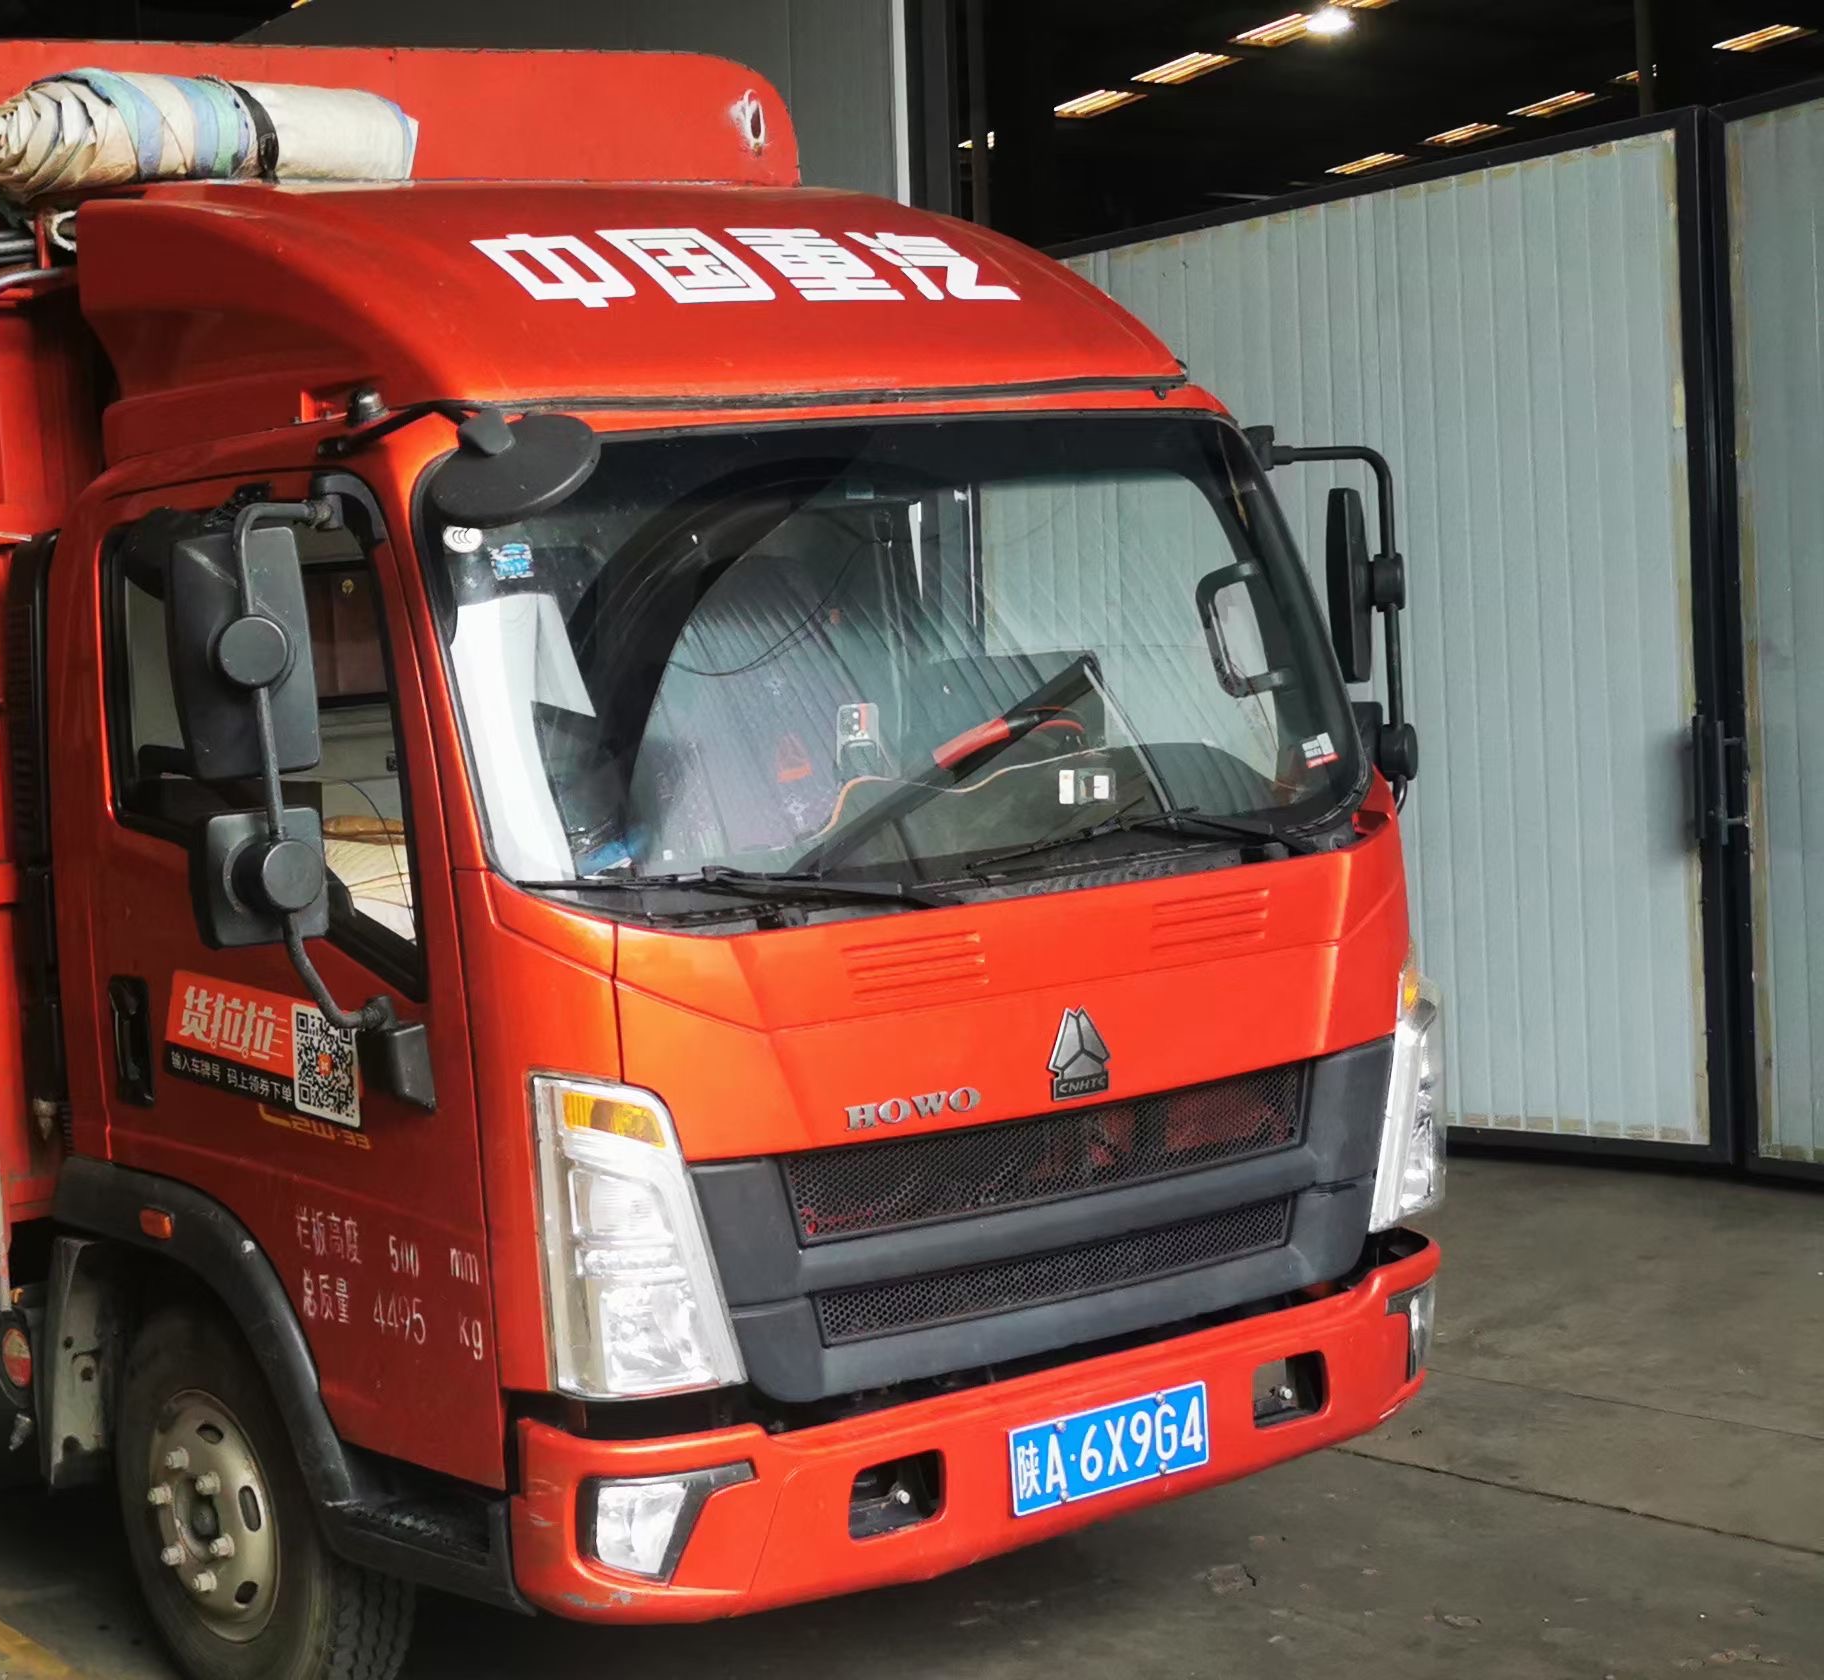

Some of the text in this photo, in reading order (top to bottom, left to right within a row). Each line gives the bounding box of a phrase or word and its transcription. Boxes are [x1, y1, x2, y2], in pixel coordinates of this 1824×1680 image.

[469, 228, 1021, 308] 中国重汽
[179, 985, 277, 1060] 货拉拉
[844, 1086, 982, 1131] HOWO
[1058, 1074, 1107, 1094] CNHTC
[449, 1246, 480, 1286] mm
[302, 1267, 351, 1325] 总质量
